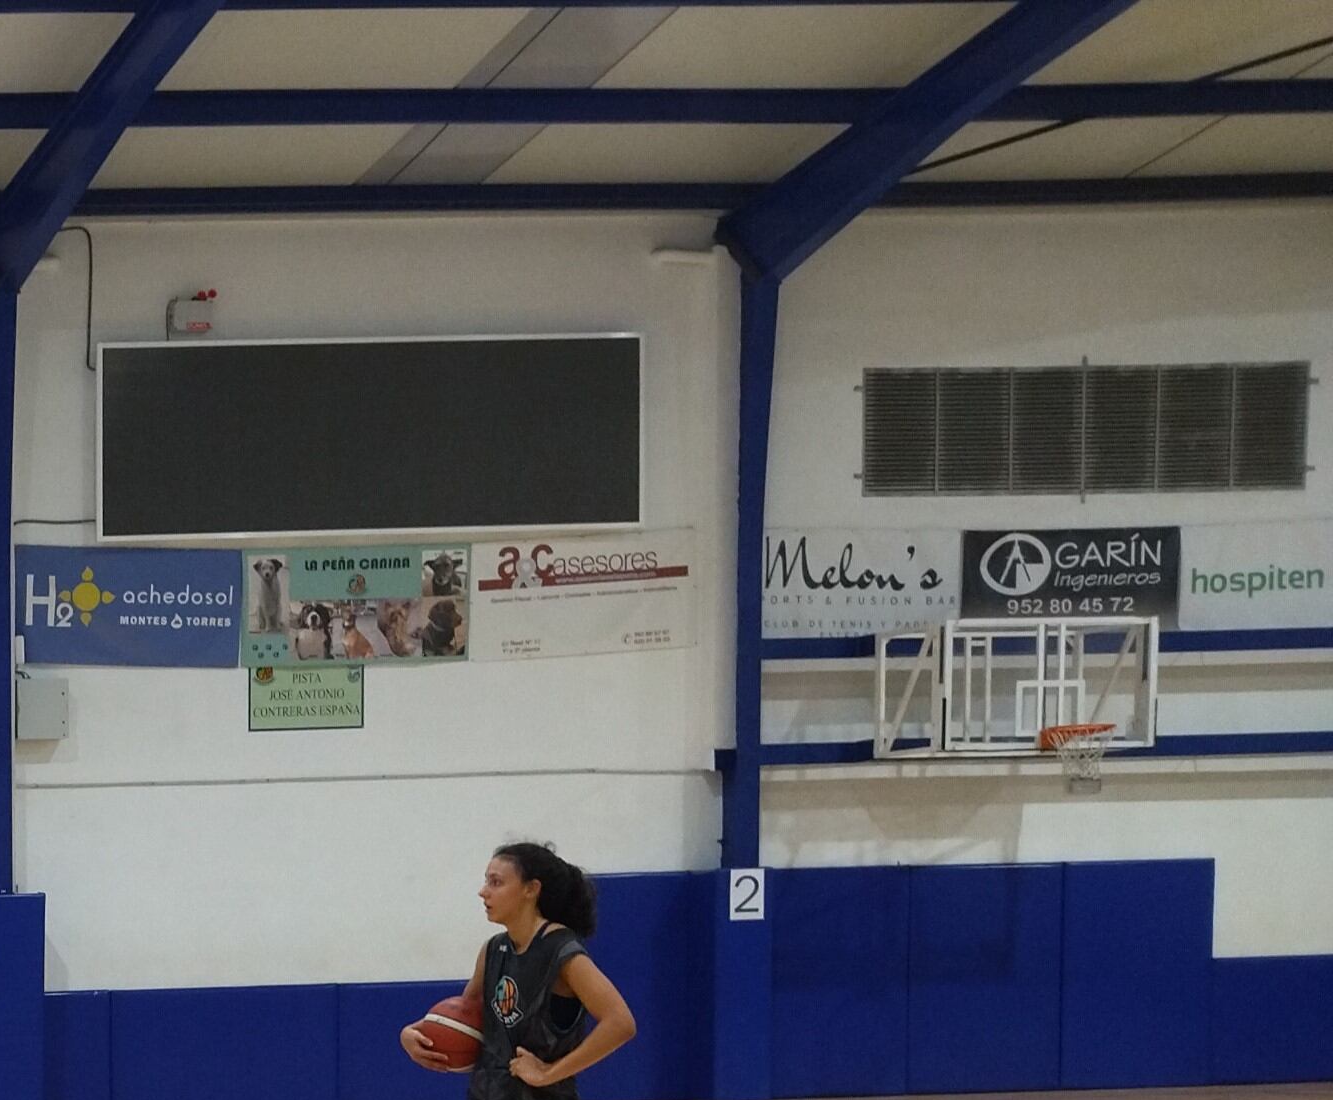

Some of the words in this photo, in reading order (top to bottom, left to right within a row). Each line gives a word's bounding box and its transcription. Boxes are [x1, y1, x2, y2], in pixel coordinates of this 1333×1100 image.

[1054, 533, 1162, 569] GARÍN
[305, 560, 318, 572] LA
[322, 556, 355, 571] PEÑA
[359, 557, 410, 570] CANINA
[553, 550, 658, 576] asesores
[764, 536, 943, 591] Melon's
[1054, 570, 1161, 591] Ingenieros
[1191, 564, 1324, 599] hospiten
[123, 584, 233, 606] achedosol
[846, 595, 912, 605] FUSION
[926, 595, 956, 605] BAR
[1007, 599, 1043, 614] 952
[1050, 599, 1072, 614] 80
[1079, 598, 1103, 613] 45
[1110, 596, 1134, 612] 72
[119, 615, 167, 626] MONTES
[186, 616, 231, 627] TORRES
[293, 672, 321, 684] PISTA
[297, 688, 345, 700] ANTONIO
[254, 704, 317, 718] CONTRERAS
[319, 702, 360, 716] ESPAÑA
[734, 875, 760, 913] 2
